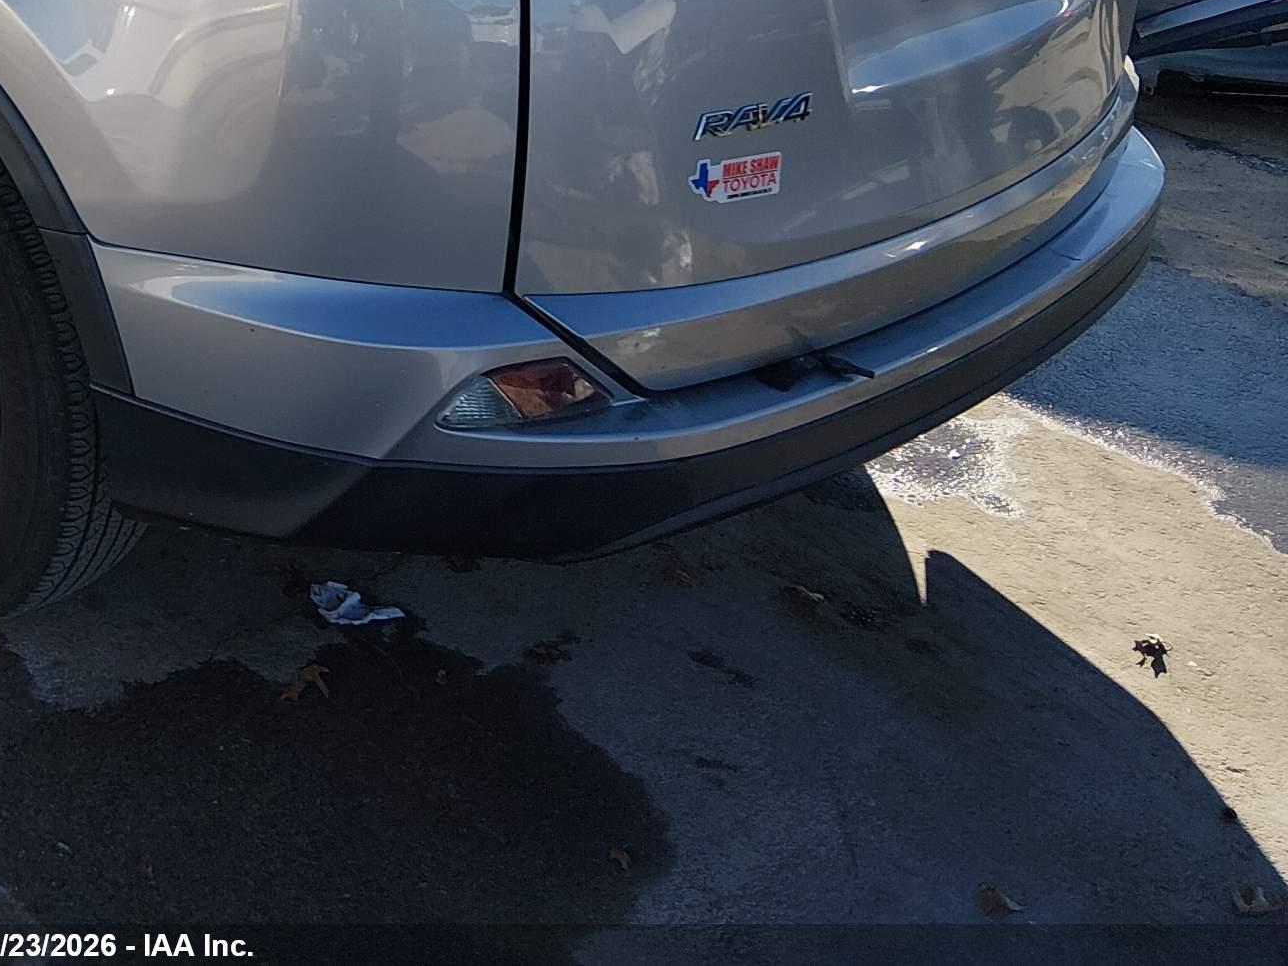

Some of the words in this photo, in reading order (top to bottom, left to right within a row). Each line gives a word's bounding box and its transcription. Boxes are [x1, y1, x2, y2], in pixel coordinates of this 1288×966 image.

[694, 91, 812, 141] RAV4
[723, 161, 748, 177] MIKE
[751, 155, 779, 172] SHAW
[722, 173, 777, 193] TOYOTA
